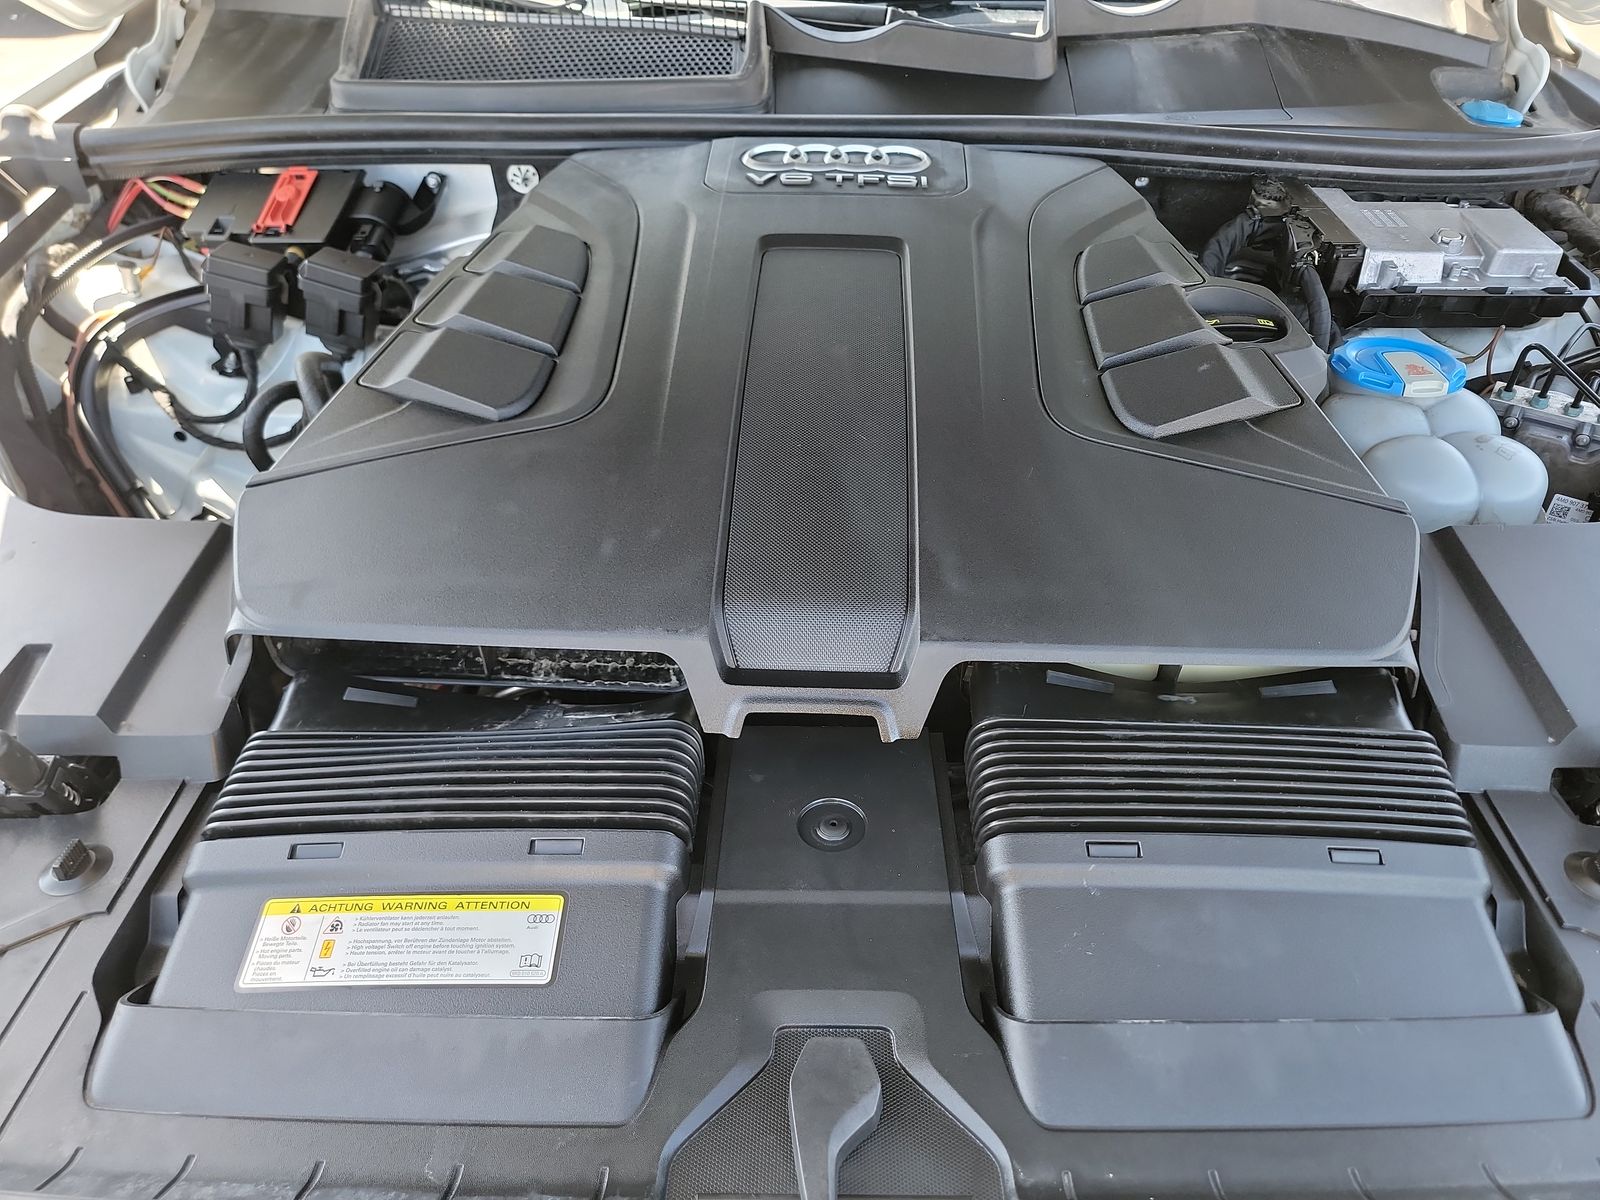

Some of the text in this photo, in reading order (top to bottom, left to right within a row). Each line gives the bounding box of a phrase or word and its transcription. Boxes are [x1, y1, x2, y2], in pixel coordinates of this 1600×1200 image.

[746, 172, 928, 189] V6 TFSI
[308, 901, 530, 913] ACHTUNG WARNING ATTENTION
